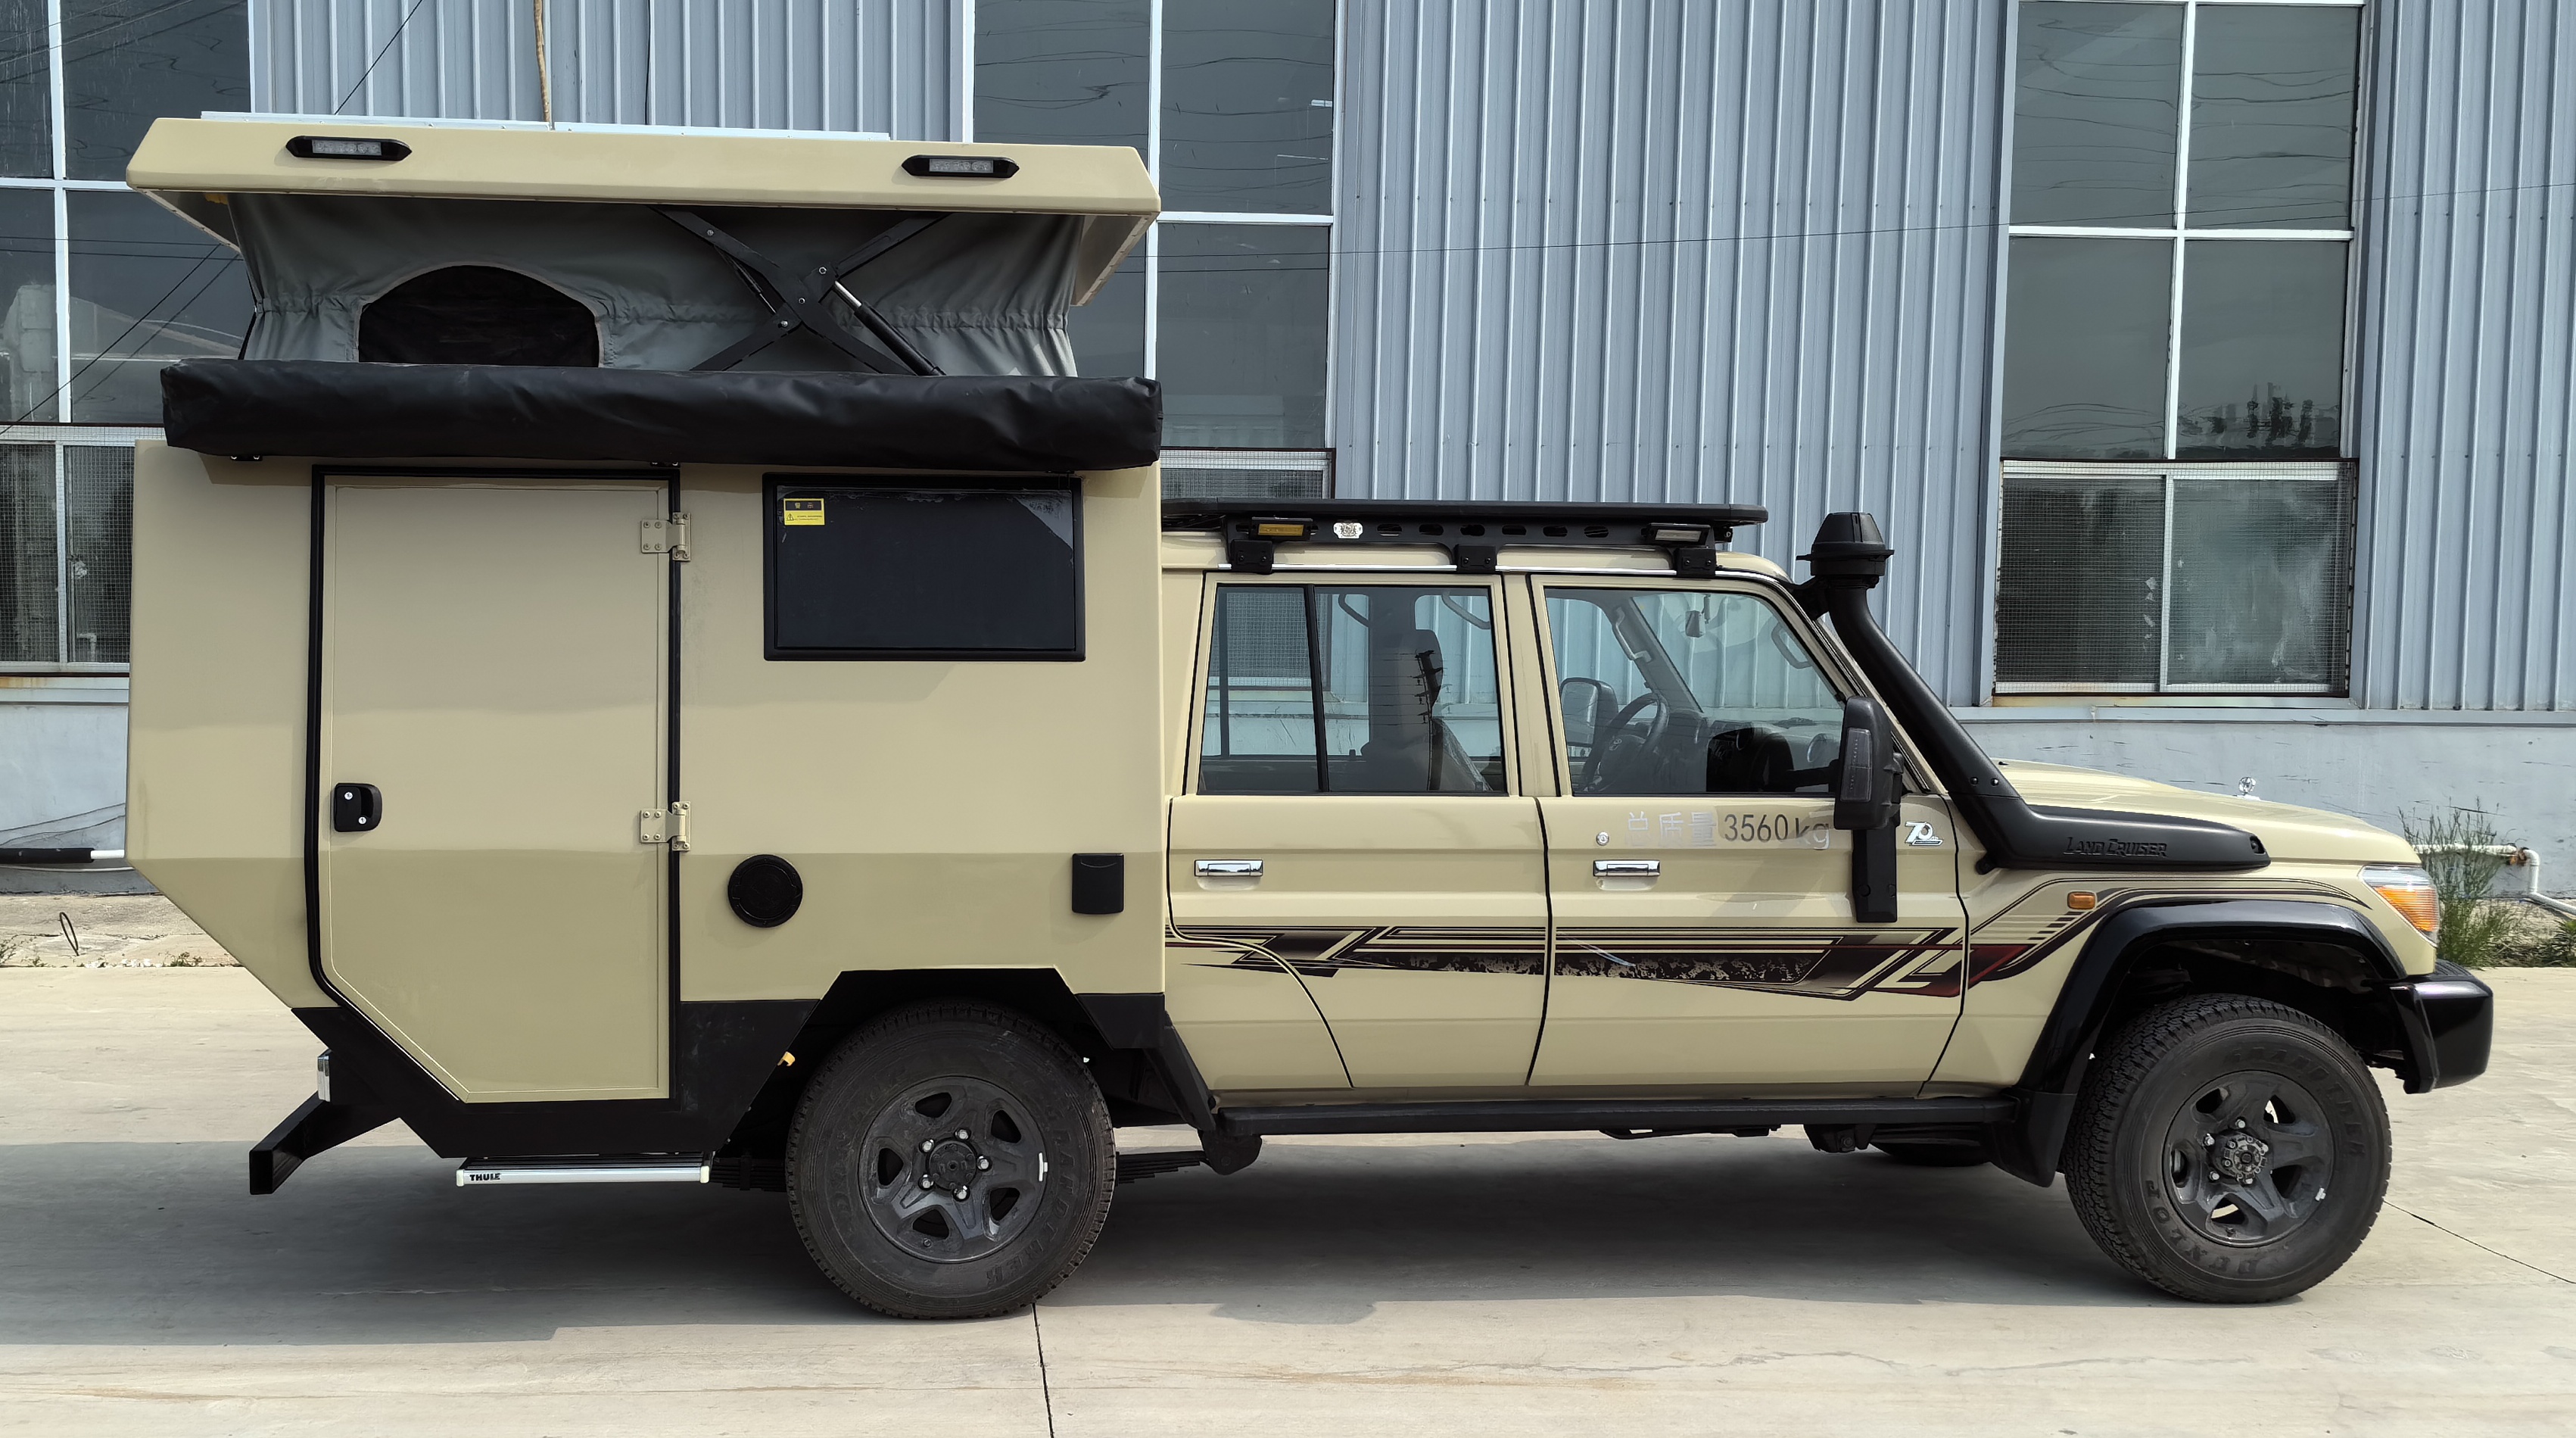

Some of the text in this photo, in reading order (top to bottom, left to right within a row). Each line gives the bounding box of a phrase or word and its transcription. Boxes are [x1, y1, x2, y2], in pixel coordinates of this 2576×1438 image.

[1627, 810, 1830, 850] 总质量 3560kg
[2063, 836, 2167, 857] LAND CRUISER
[469, 1173, 501, 1181] THULE
